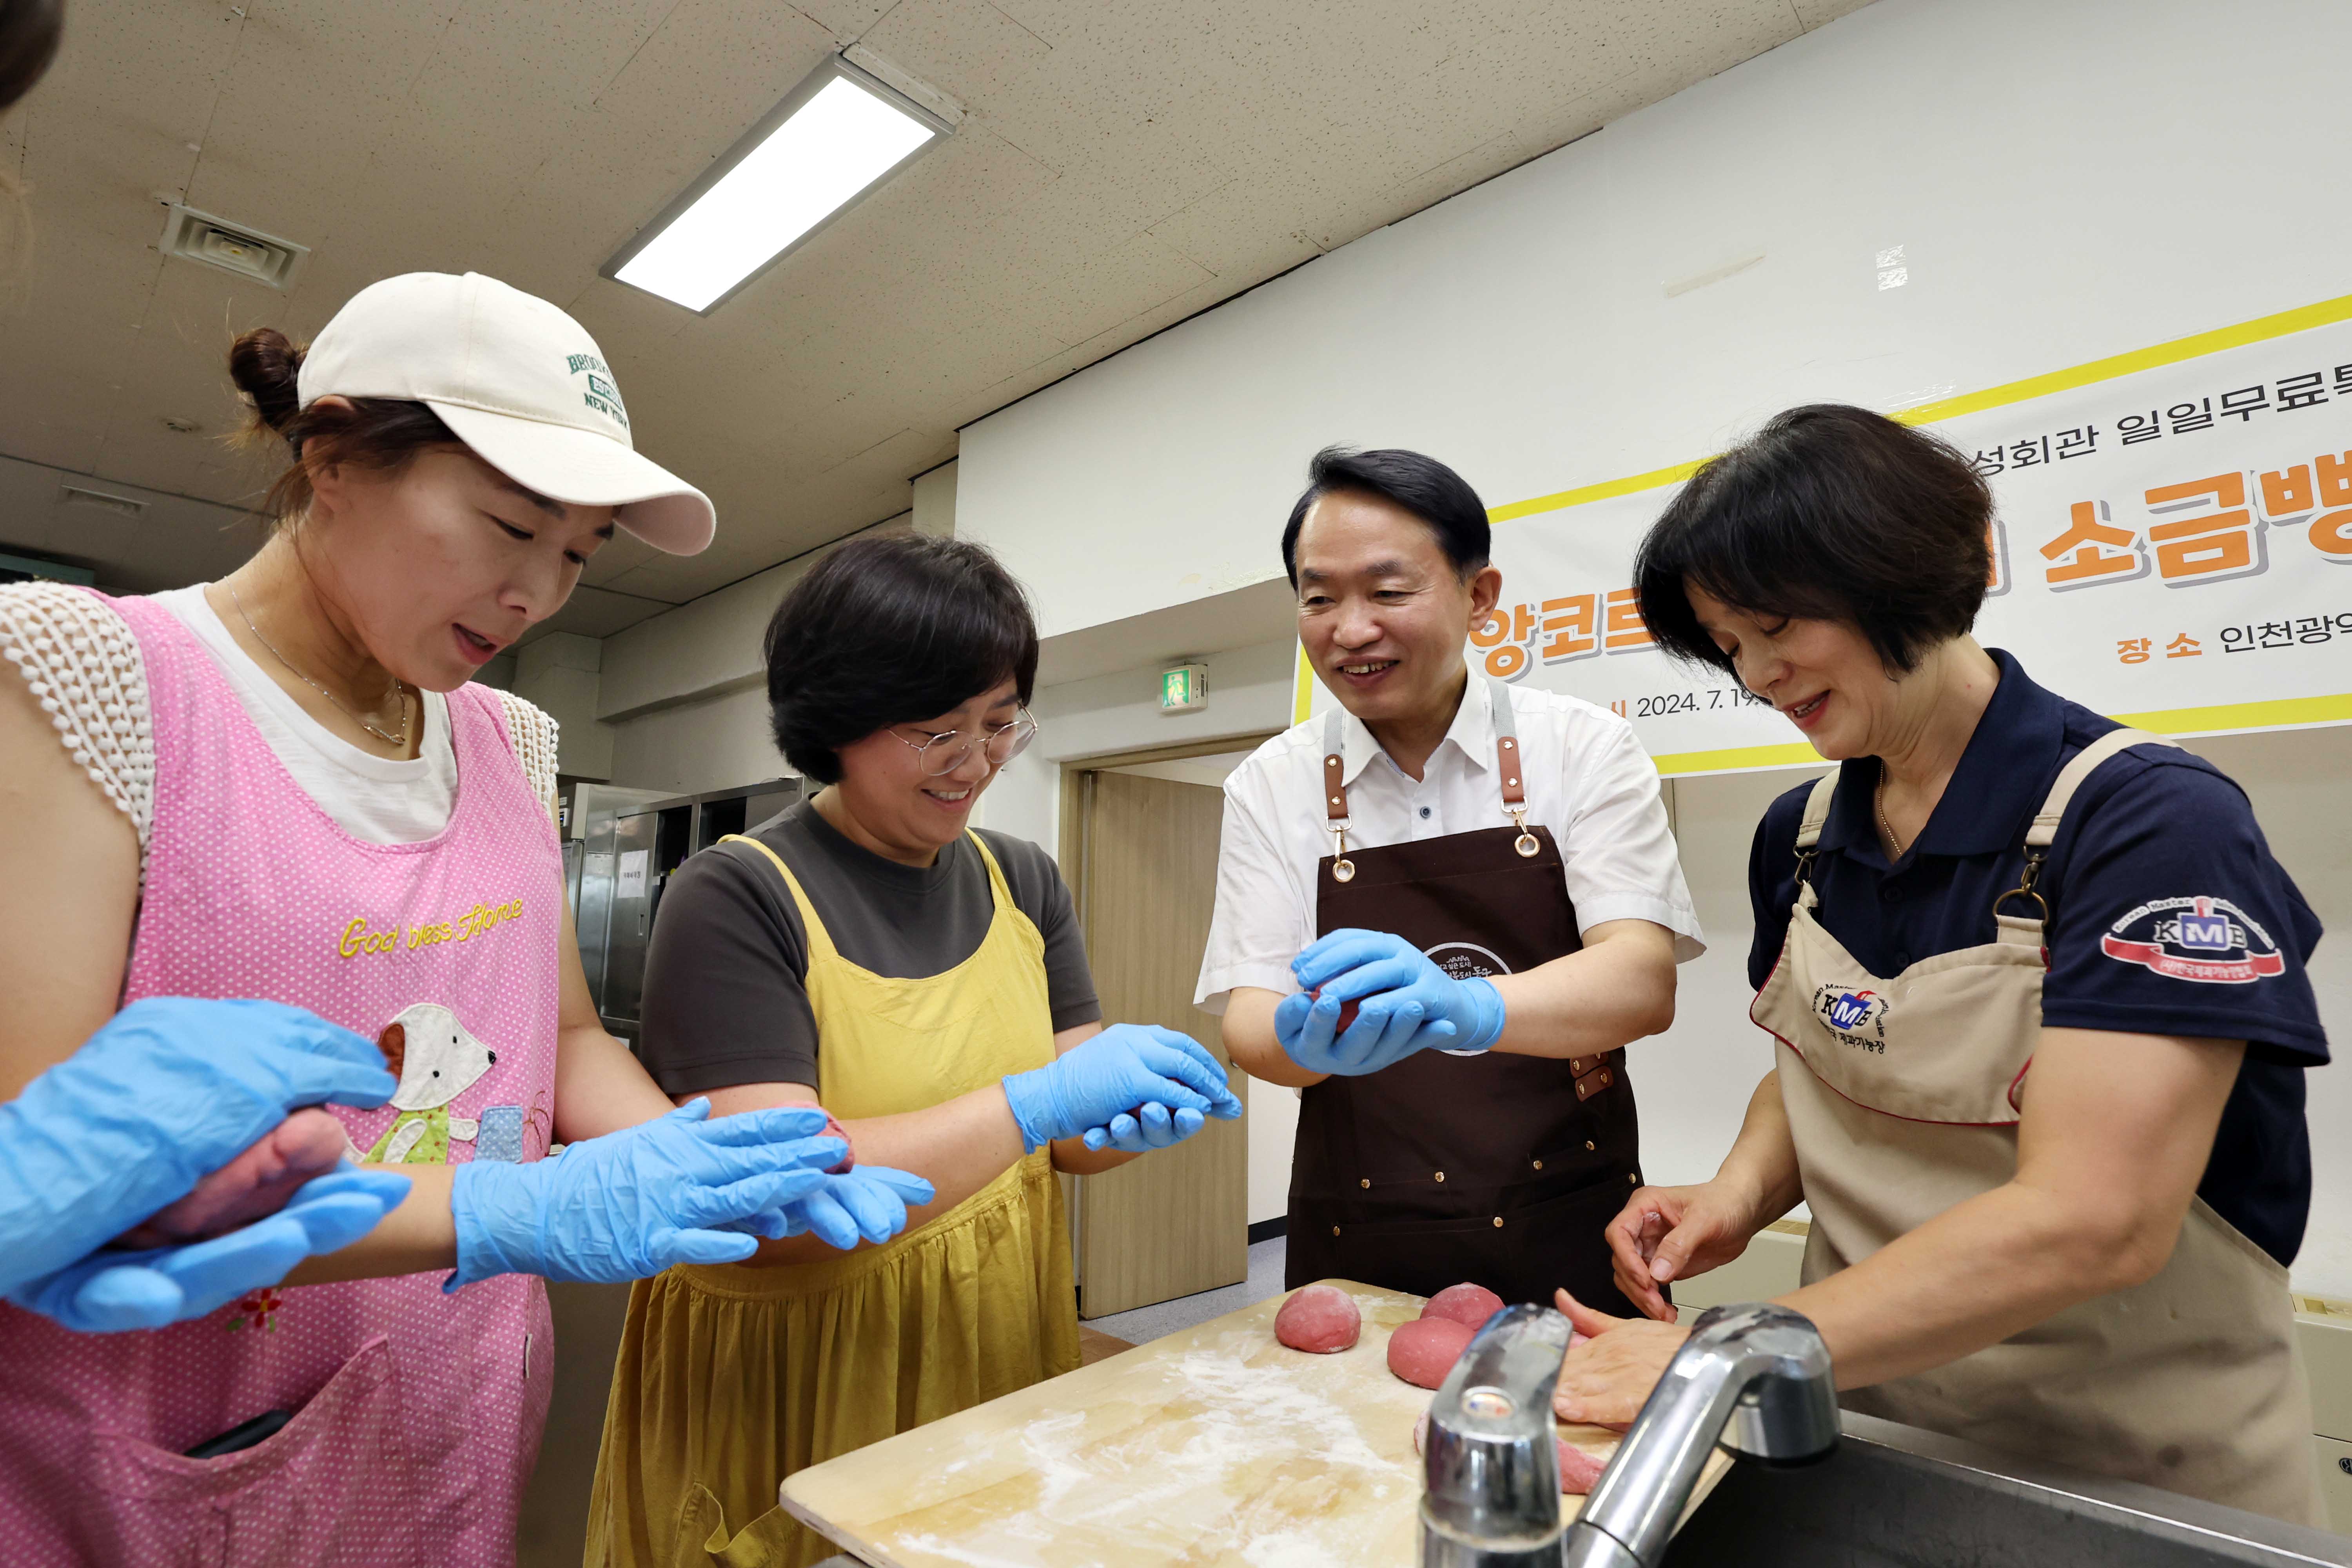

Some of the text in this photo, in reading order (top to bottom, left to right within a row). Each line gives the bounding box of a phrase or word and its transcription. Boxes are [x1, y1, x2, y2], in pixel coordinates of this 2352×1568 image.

[584, 392, 608, 415] NEW
[1971, 425, 2099, 477] 성회관
[2117, 637, 2152, 664] 장
[2166, 633, 2202, 658] 소
[1637, 693, 1700, 717] 2024.
[1707, 690, 1723, 710] 7.
[339, 917, 399, 958] God
[407, 921, 452, 949] bless
[2156, 921, 2245, 945] KMB
[1821, 994, 1873, 1026] KMB
